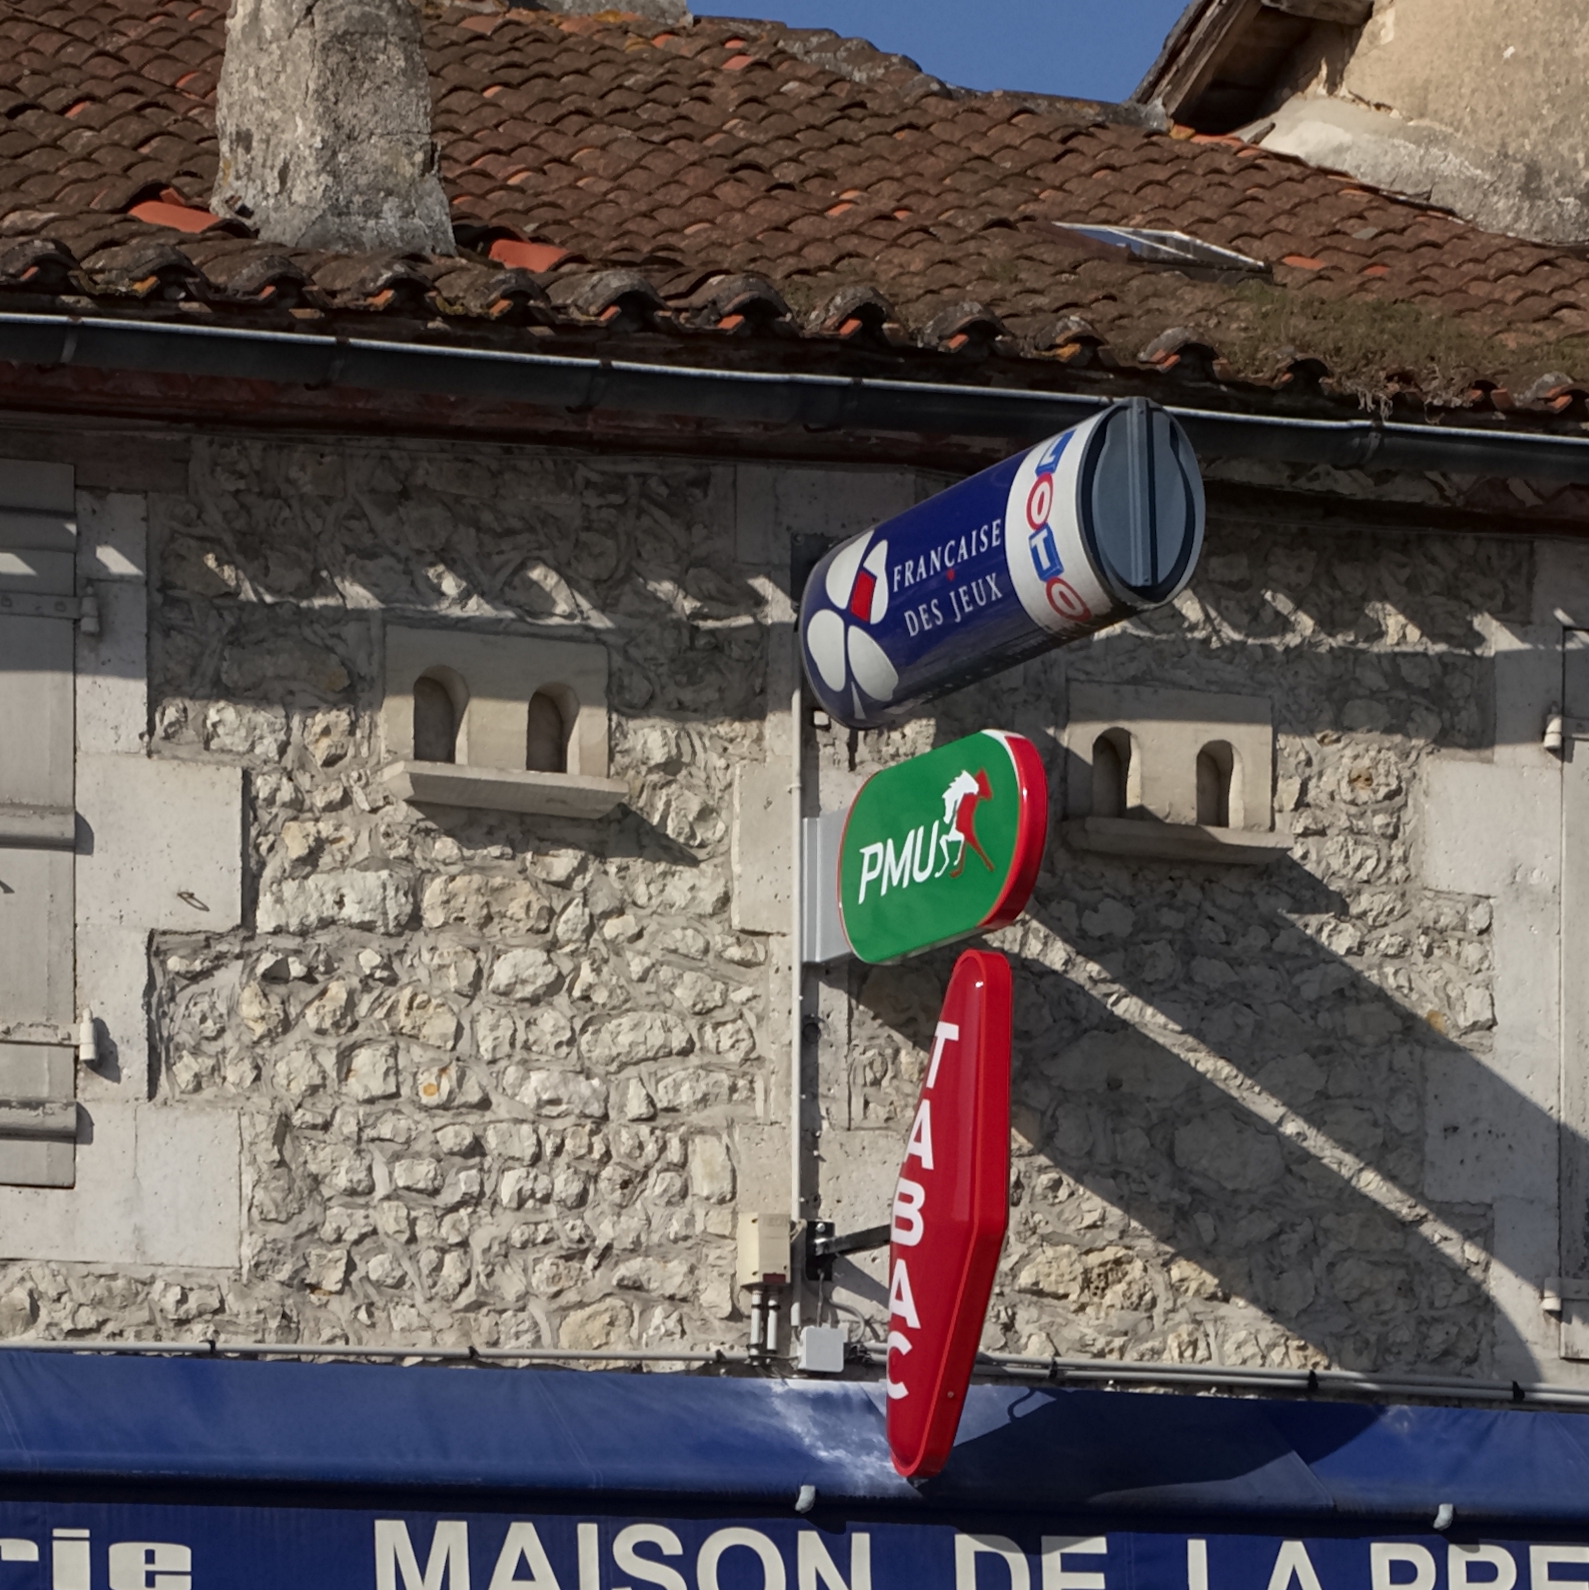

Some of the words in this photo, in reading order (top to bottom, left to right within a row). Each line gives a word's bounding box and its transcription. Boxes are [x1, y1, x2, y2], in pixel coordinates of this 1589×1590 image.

[893, 519, 1002, 592] FRANÇAISE
[1026, 428, 1092, 622] LOTO
[904, 598, 944, 637] DES
[953, 572, 1003, 624] JEUX
[858, 818, 940, 904] PMU
[886, 1021, 959, 1400] TABAC
